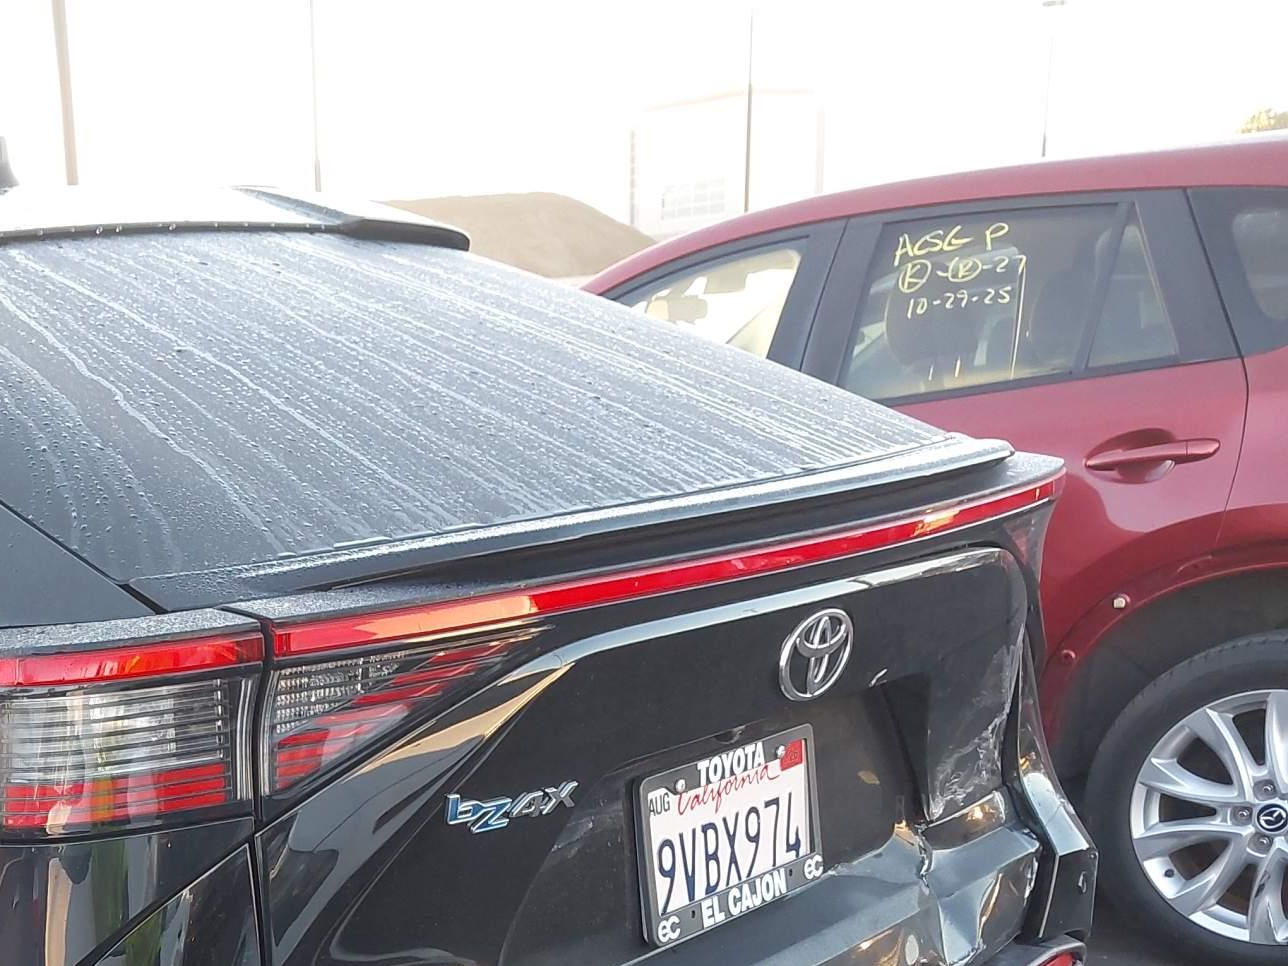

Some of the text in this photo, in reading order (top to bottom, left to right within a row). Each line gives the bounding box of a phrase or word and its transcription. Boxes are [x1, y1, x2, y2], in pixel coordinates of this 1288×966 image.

[678, 763, 780, 816] California
[697, 742, 765, 787] TOYOTA
[648, 793, 671, 817] AUG
[658, 792, 802, 916] 9VBX974
[701, 868, 787, 928] EL CAJON
